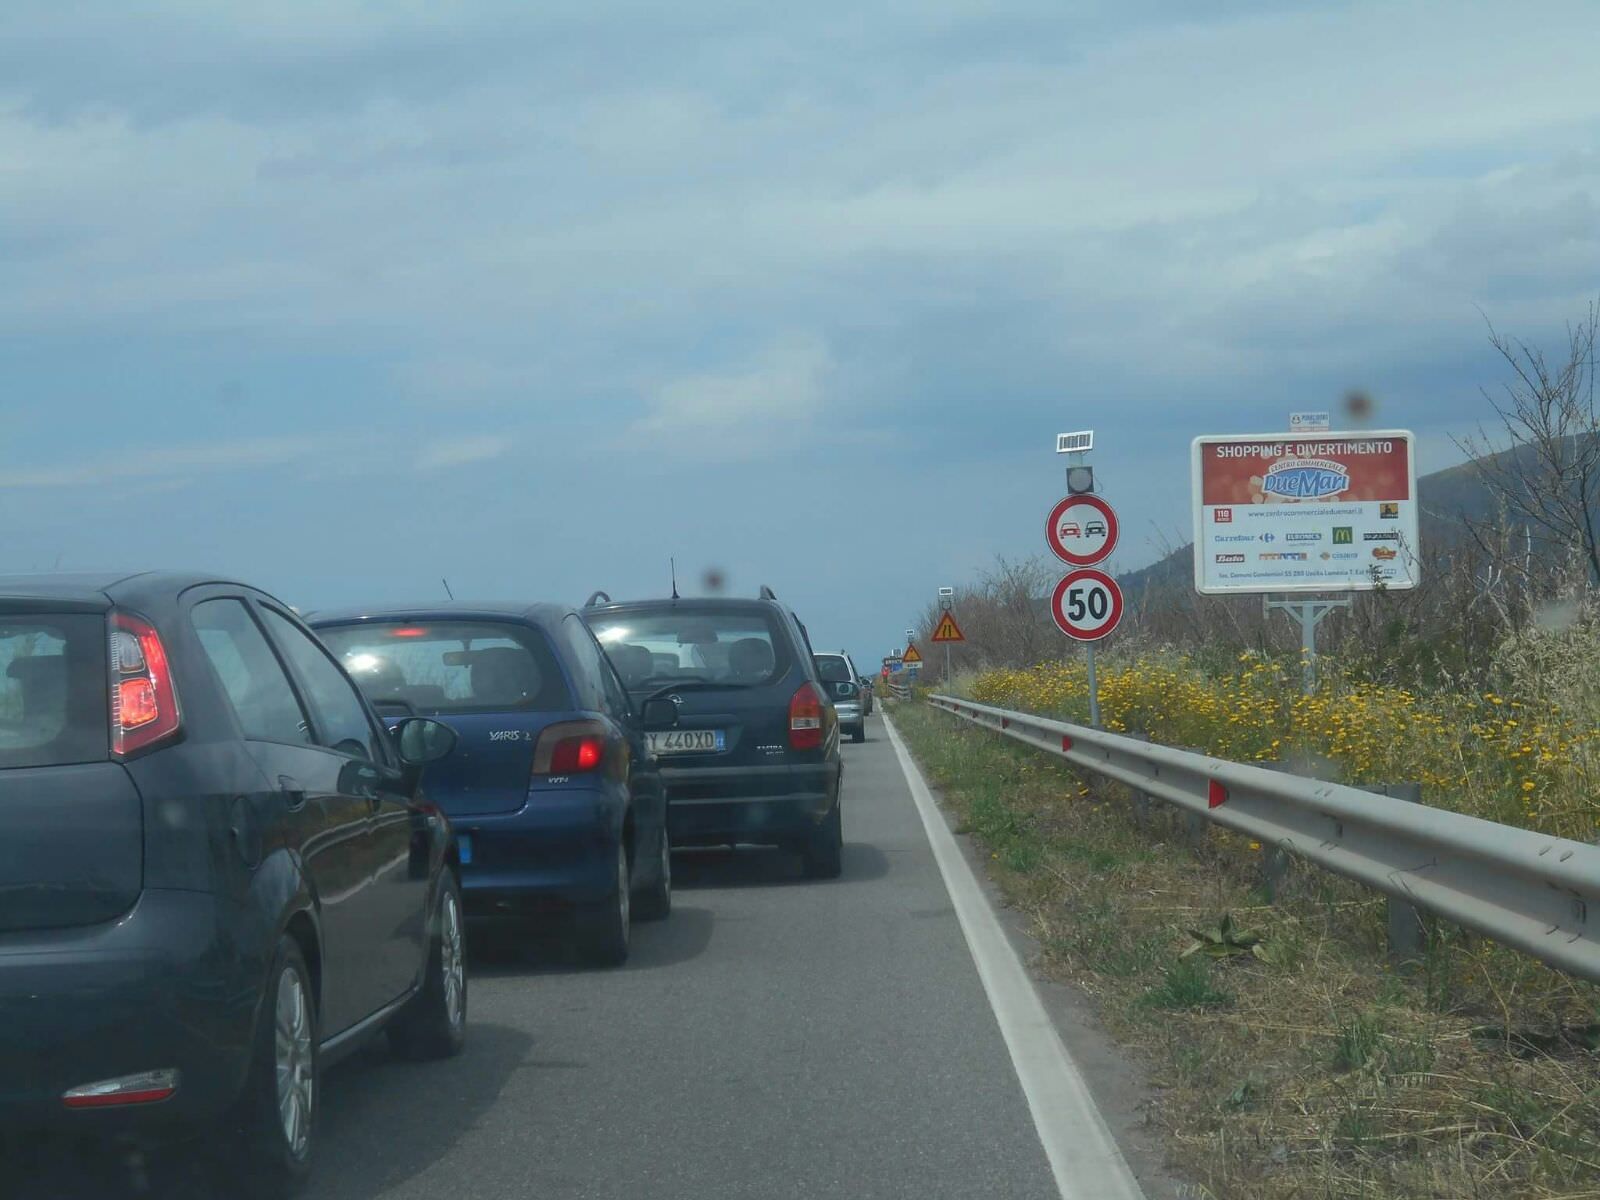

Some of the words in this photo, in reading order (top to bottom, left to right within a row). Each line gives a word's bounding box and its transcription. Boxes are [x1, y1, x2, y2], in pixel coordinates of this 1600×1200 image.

[1216, 445, 1282, 458] SHOPPING
[1285, 444, 1294, 456] E
[1296, 441, 1393, 456] DIVERTIMENTO
[1271, 461, 1295, 472] CENTRO
[1296, 460, 1345, 472] COMMERCIALE
[1067, 586, 1108, 622] 50
[489, 730, 520, 741] YARIS
